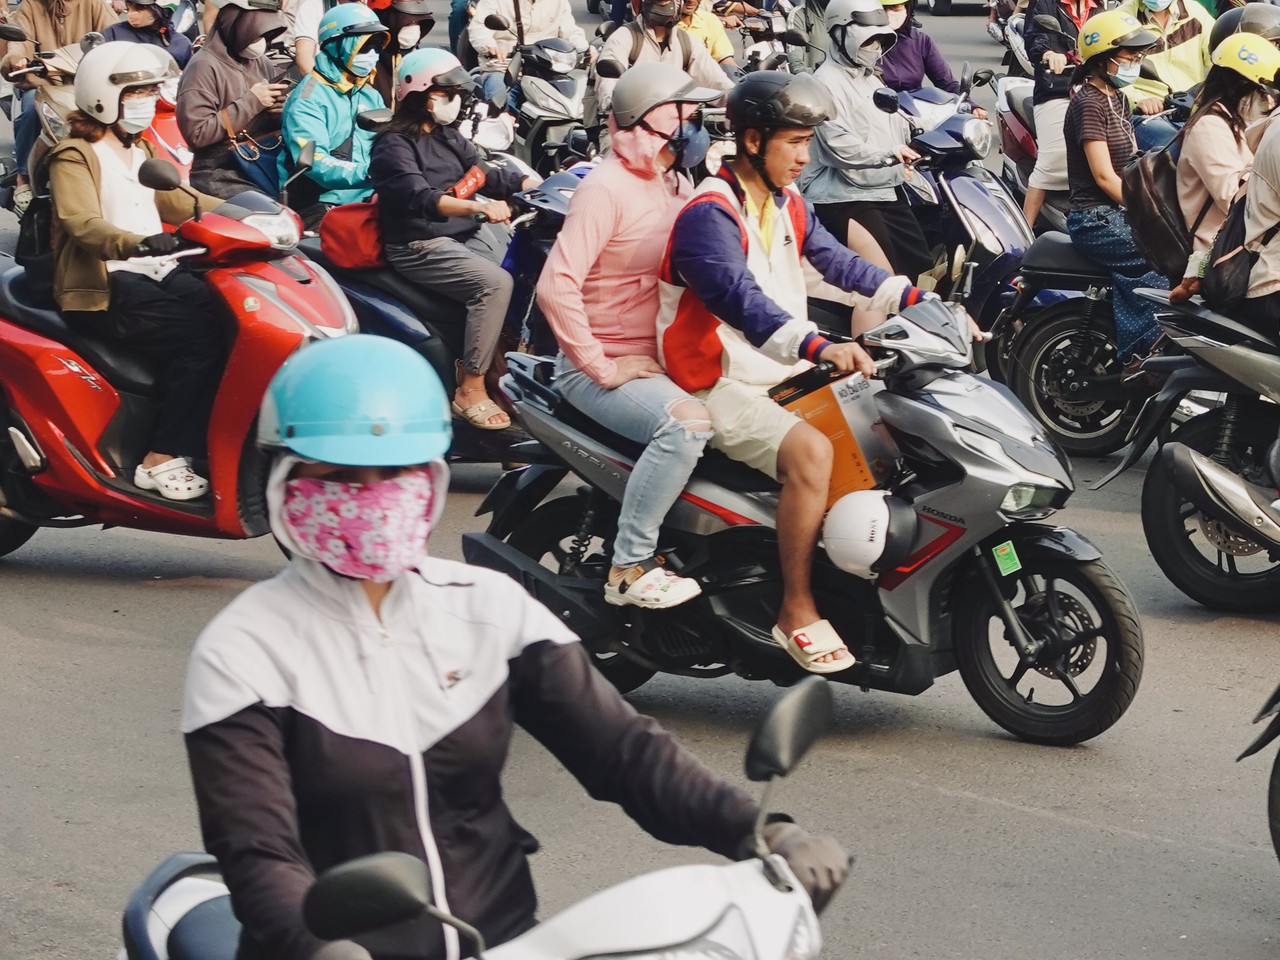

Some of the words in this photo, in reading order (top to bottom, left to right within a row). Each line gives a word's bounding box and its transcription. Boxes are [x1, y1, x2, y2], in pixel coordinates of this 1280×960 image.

[1083, 31, 1101, 46] be
[1238, 44, 1258, 64] be
[921, 505, 966, 525] HONDA
